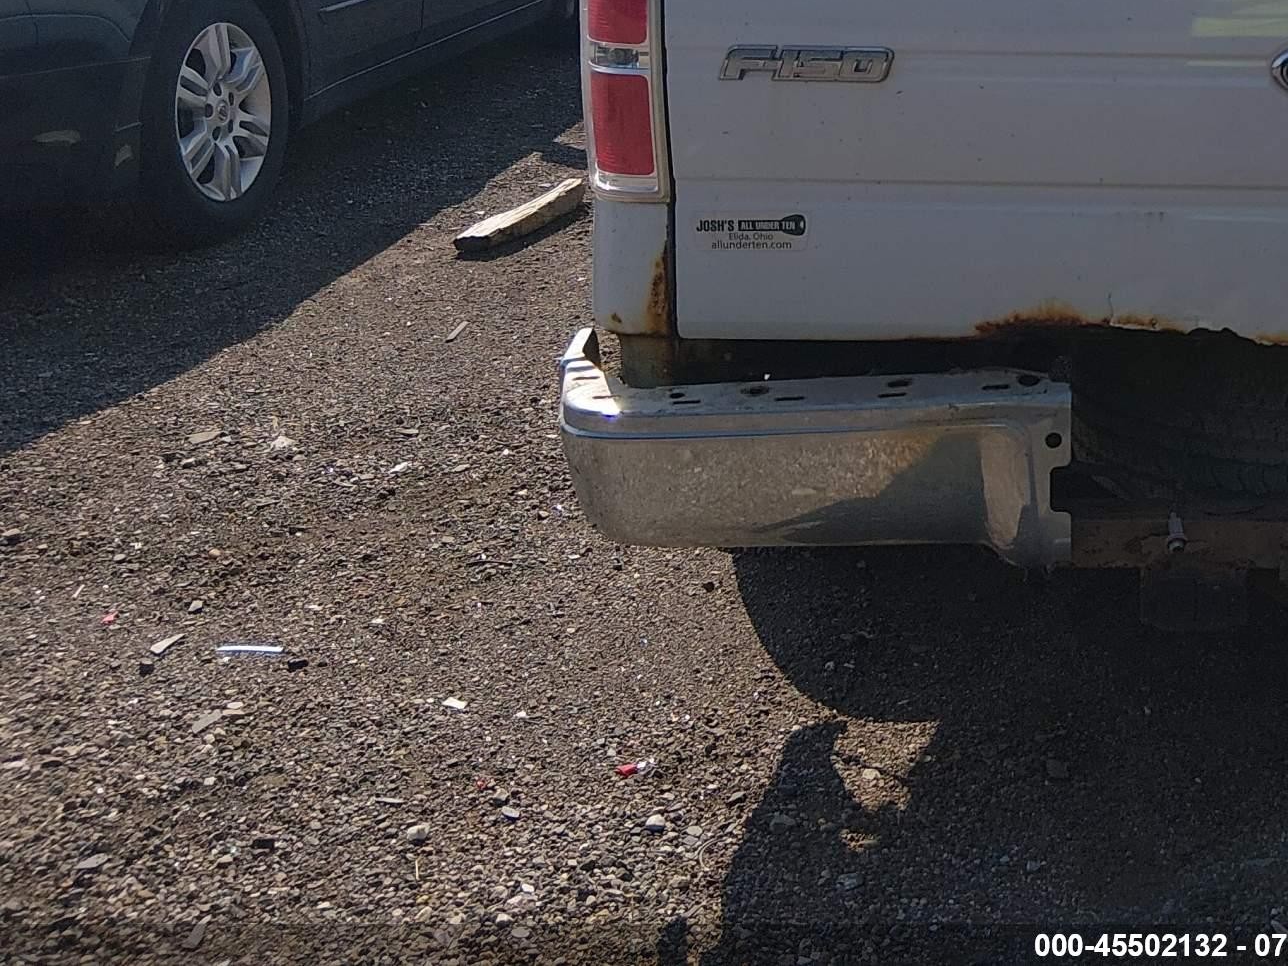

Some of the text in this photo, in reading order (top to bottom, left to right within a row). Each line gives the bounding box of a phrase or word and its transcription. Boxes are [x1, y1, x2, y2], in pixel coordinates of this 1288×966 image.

[696, 220, 795, 232] JOSH'S ALL UNDER TEN
[711, 240, 792, 250] allunderten.com
